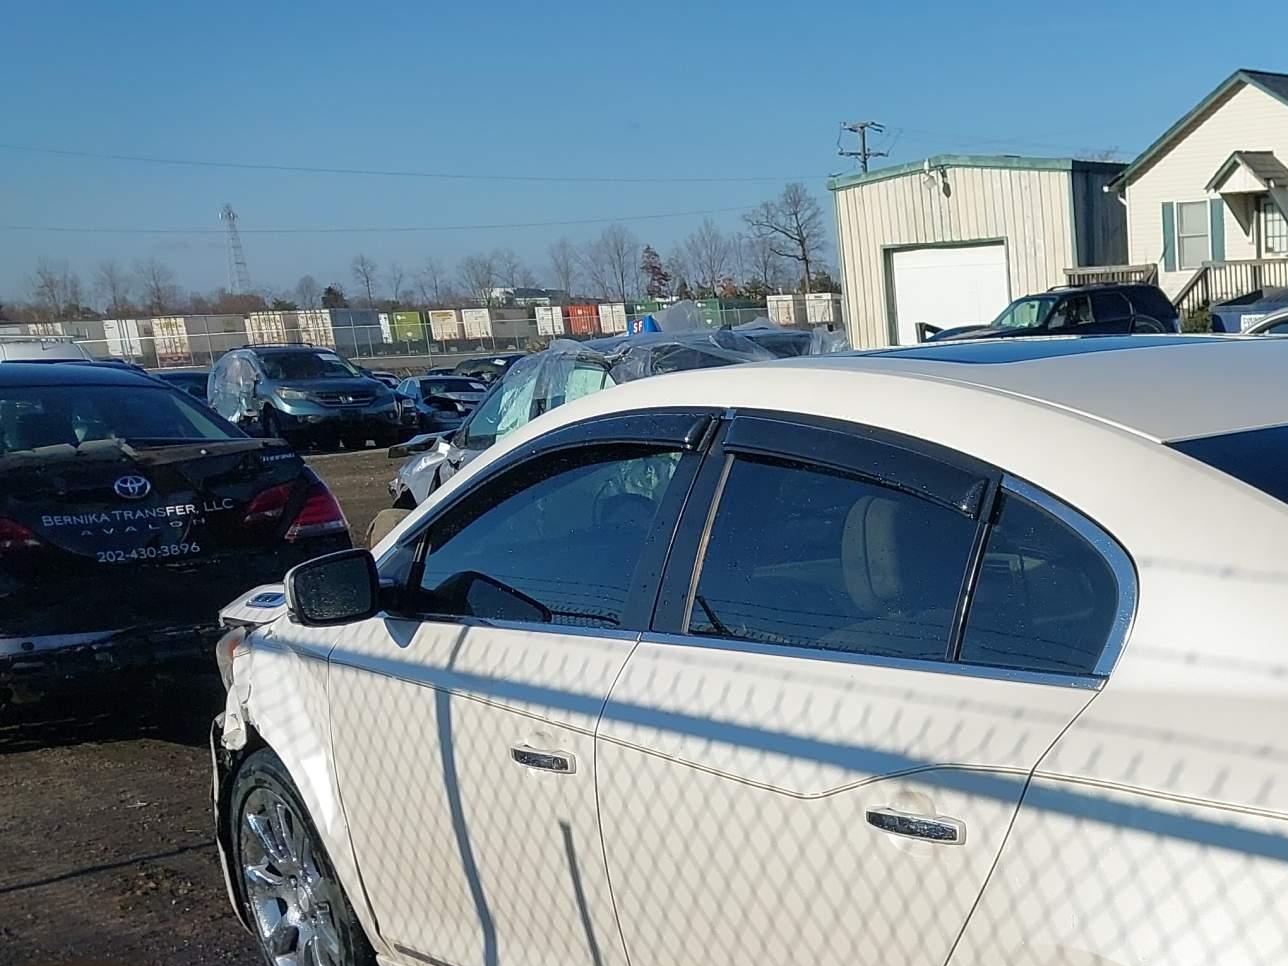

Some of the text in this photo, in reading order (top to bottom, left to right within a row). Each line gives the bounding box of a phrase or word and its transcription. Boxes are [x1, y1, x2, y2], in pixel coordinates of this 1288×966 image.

[41, 512, 112, 528] BERNIKA
[203, 498, 235, 512] LLC
[80, 517, 206, 537] AVALON
[98, 541, 201, 563] 202-430-3896
